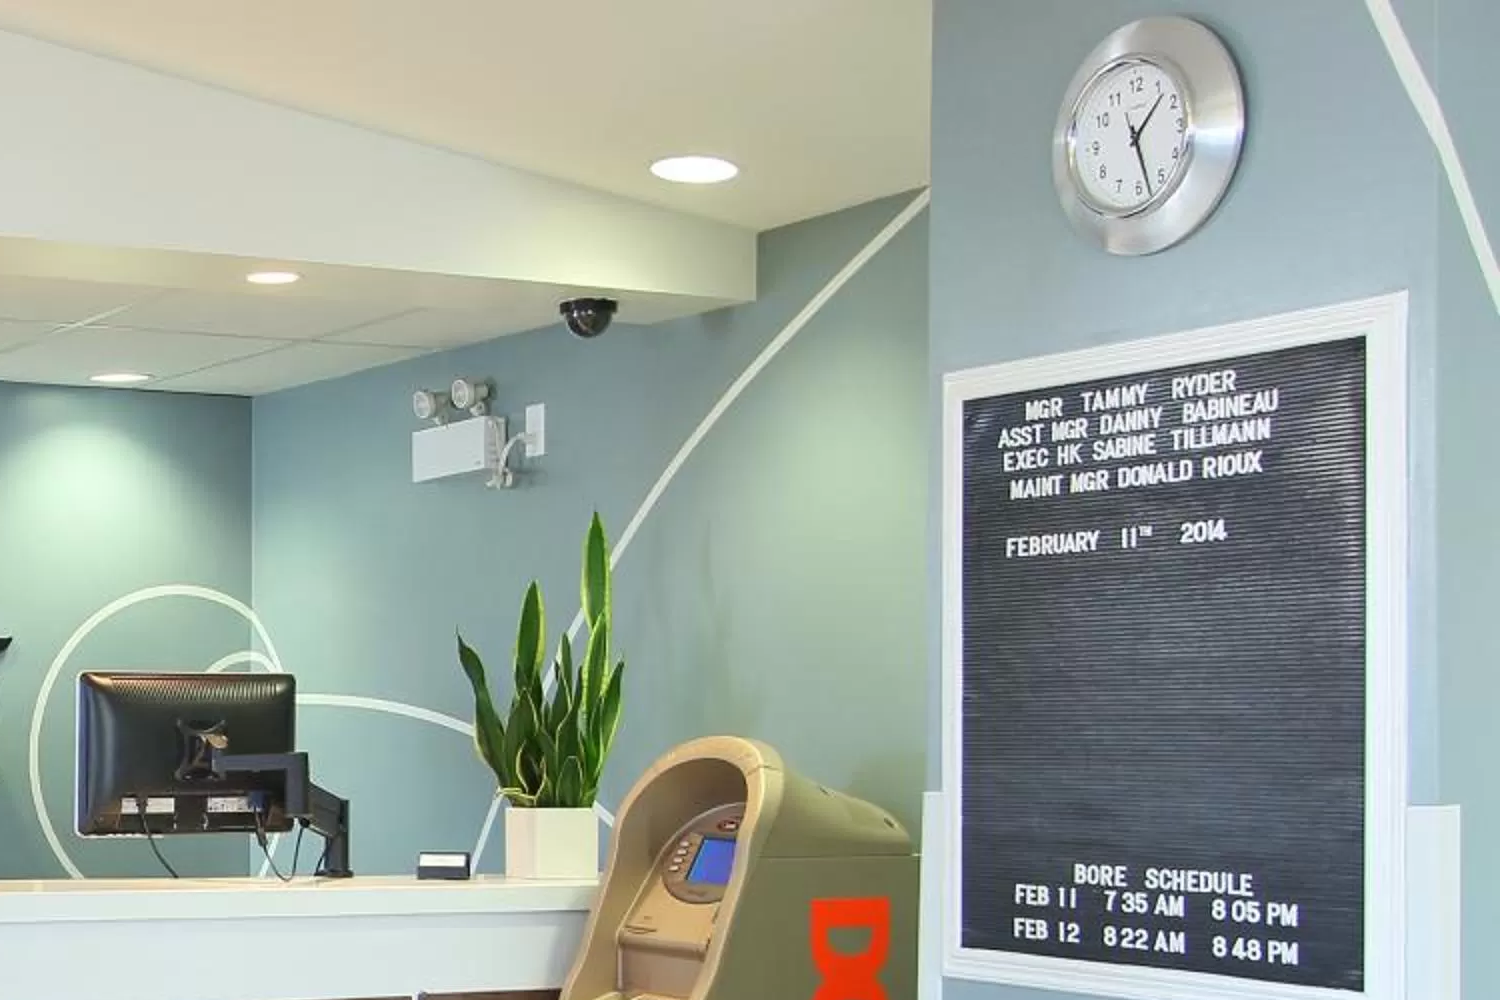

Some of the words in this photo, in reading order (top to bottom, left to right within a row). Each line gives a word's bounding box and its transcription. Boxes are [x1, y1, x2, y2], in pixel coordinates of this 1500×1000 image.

[1130, 77, 1143, 93] 12
[1155, 81, 1162, 93] 1
[1109, 92, 1121, 106] 11
[1170, 94, 1178, 109] 2
[1096, 112, 1109, 128] 10
[1092, 141, 1100, 155] 9
[1158, 169, 1165, 184] 5
[1115, 179, 1123, 193] 7
[1135, 181, 1142, 195] 6
[1025, 397, 1063, 422] MGR
[1079, 382, 1149, 413] TAMMY
[1171, 369, 1237, 400] RYDER
[998, 423, 1045, 449] ASST
[1051, 417, 1089, 442] MGR
[1100, 406, 1163, 435] DANNY
[1182, 387, 1279, 424] BABINEAU
[1003, 448, 1049, 472] EXEC
[1057, 443, 1083, 466] HK
[1092, 433, 1157, 461] SABINE
[1169, 417, 1272, 451] TILLMANN
[1009, 474, 1065, 500] MAINT
[1069, 469, 1109, 494] MGR
[1117, 459, 1193, 488] DONALD
[1202, 450, 1263, 479] RIOUX
[1006, 530, 1100, 558] FEBRUARY
[1180, 518, 1228, 544] 2014
[1074, 863, 1128, 887] BORE
[1145, 868, 1254, 897] SCHEDULE
[1014, 883, 1050, 907] FEB
[1058, 887, 1078, 909] 11
[1154, 894, 1185, 918] AM
[1266, 902, 1298, 928] PM
[1013, 917, 1049, 941] FEB
[1059, 921, 1080, 943] 12
[1154, 930, 1185, 954] AM
[1267, 940, 1298, 966] PM
